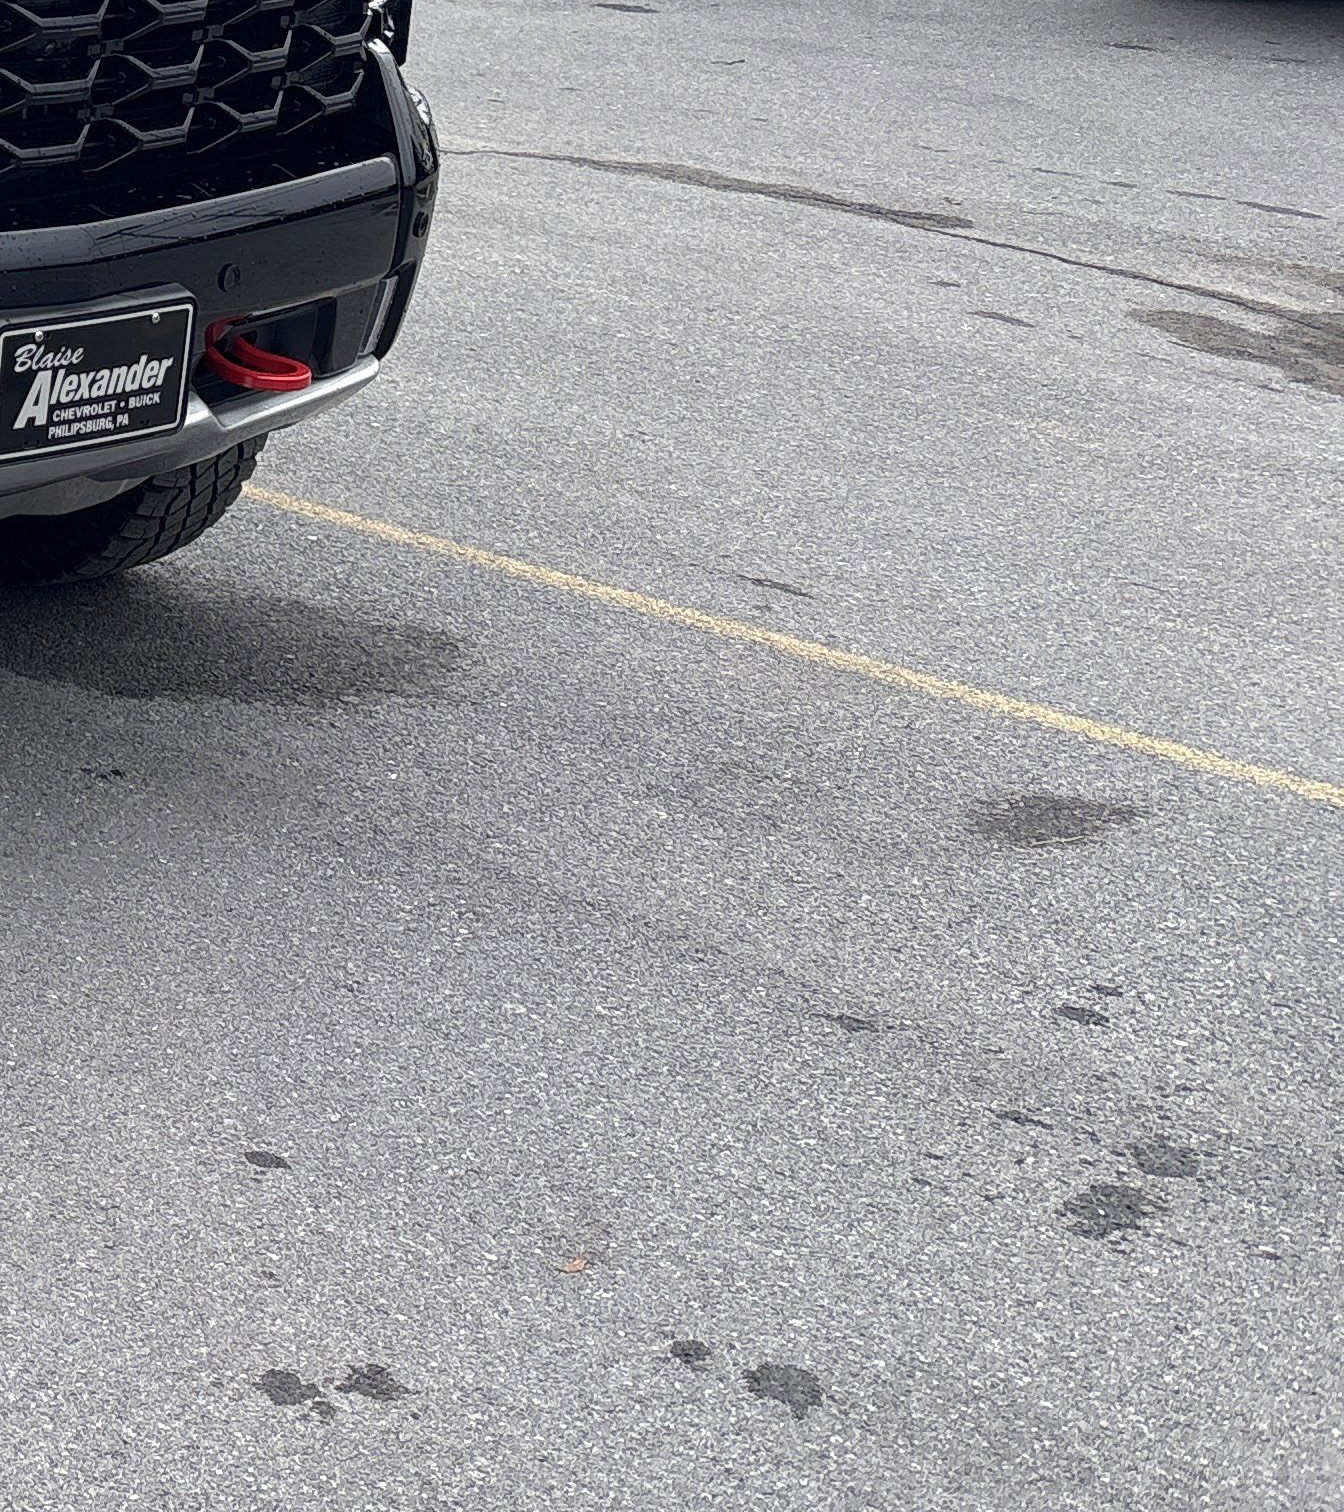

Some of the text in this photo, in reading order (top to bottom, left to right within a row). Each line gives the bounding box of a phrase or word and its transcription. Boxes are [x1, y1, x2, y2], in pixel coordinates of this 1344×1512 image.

[14, 343, 85, 373] Blaise
[13, 354, 175, 430] Alexander
[52, 392, 161, 423] CHEVROLET BUICK
[48, 413, 130, 439] PHILIPSBURG, PA
